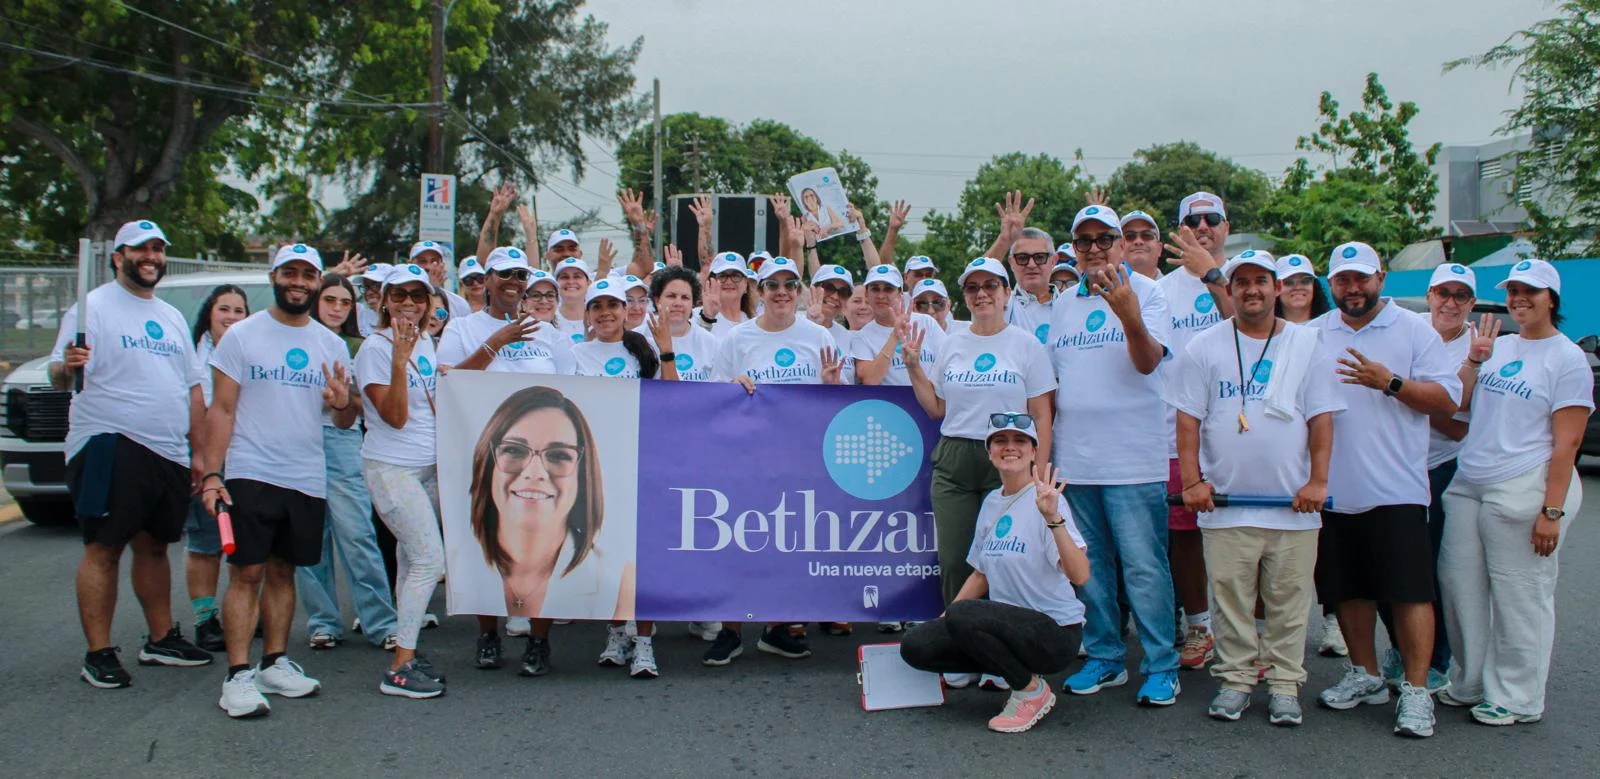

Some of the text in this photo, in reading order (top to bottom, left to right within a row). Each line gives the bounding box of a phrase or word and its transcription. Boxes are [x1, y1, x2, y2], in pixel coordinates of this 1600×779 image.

[1171, 308, 1222, 330] Bethzai
[1056, 327, 1125, 349] Bethzaida
[746, 363, 817, 382] Bethzaida
[667, 487, 939, 554] Bethza
[808, 561, 942, 580] Una nueva etapa
